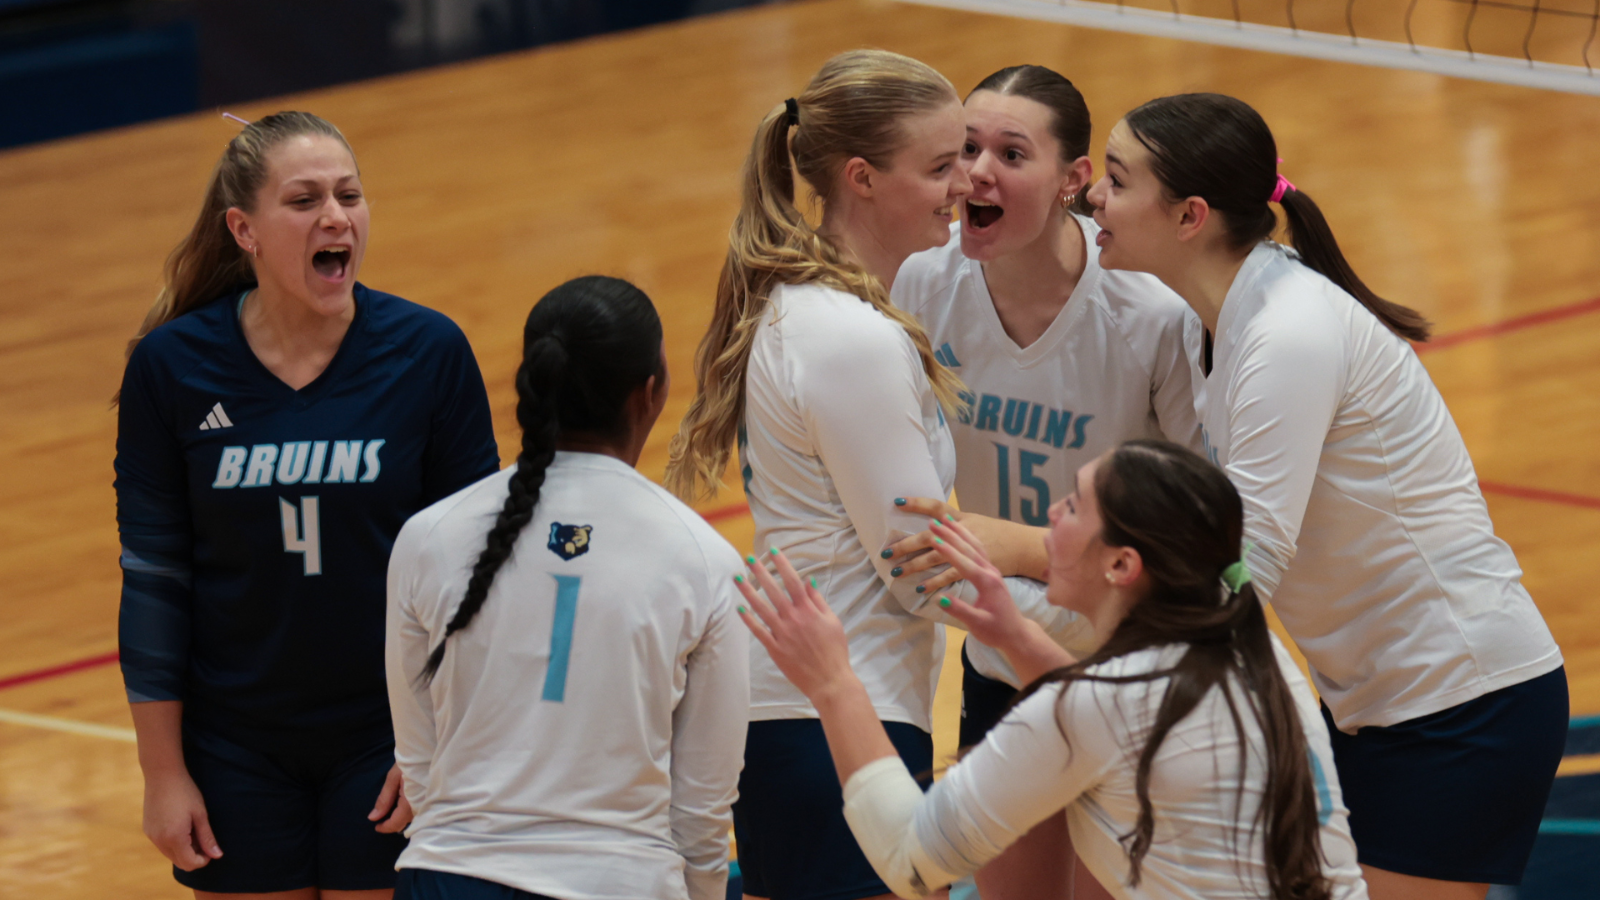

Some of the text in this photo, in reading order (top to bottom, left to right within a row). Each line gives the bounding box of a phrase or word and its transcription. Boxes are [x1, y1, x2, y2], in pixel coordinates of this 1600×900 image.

[212, 439, 386, 489] BRUINS
[991, 441, 1051, 527] 15
[278, 495, 322, 576] 4
[540, 572, 583, 703] 1
